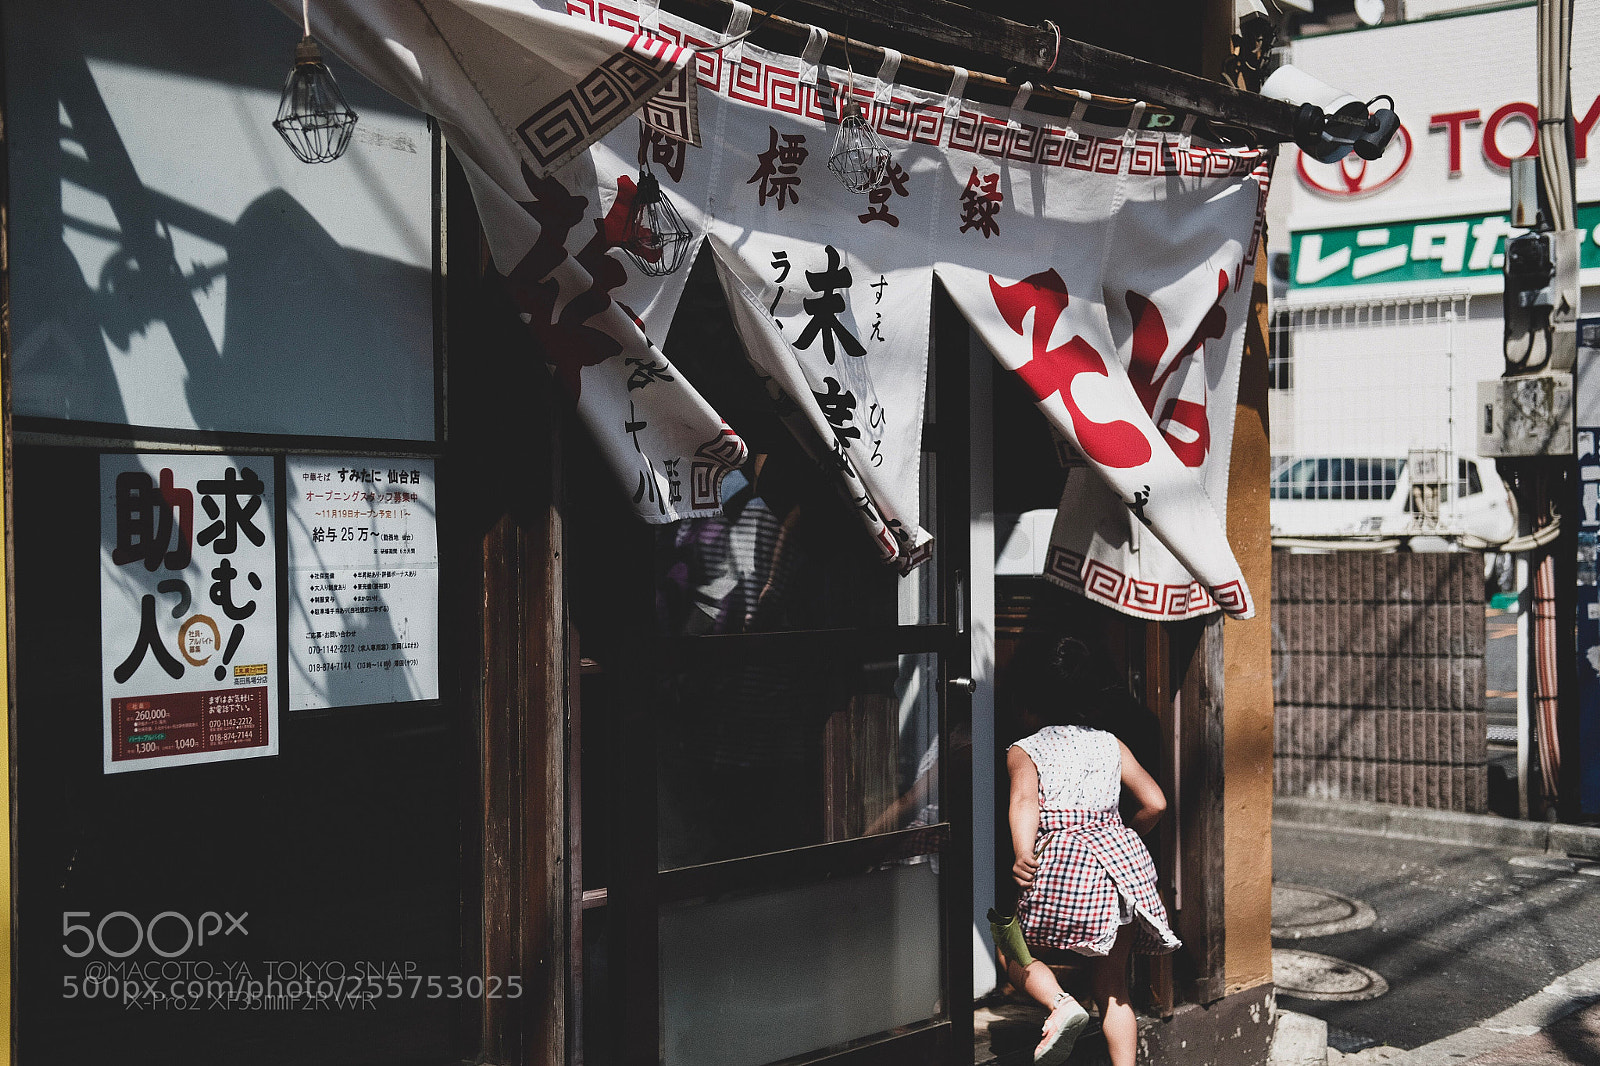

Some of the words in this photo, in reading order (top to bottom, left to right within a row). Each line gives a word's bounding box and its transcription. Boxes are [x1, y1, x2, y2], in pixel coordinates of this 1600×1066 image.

[302, 472, 331, 482] 中華そば
[337, 467, 382, 483] すみたに
[387, 468, 420, 484] 仙台店
[306, 489, 418, 504] オープニングスタッフ募集中
[112, 467, 194, 684] 助っ人
[308, 644, 355, 654] 070-1142-2212
[308, 661, 351, 673] 018-874-7144
[208, 694, 254, 705] まずはお気軽に
[208, 716, 253, 728] 070-1142-2212
[209, 730, 253, 742] 018-874-7144
